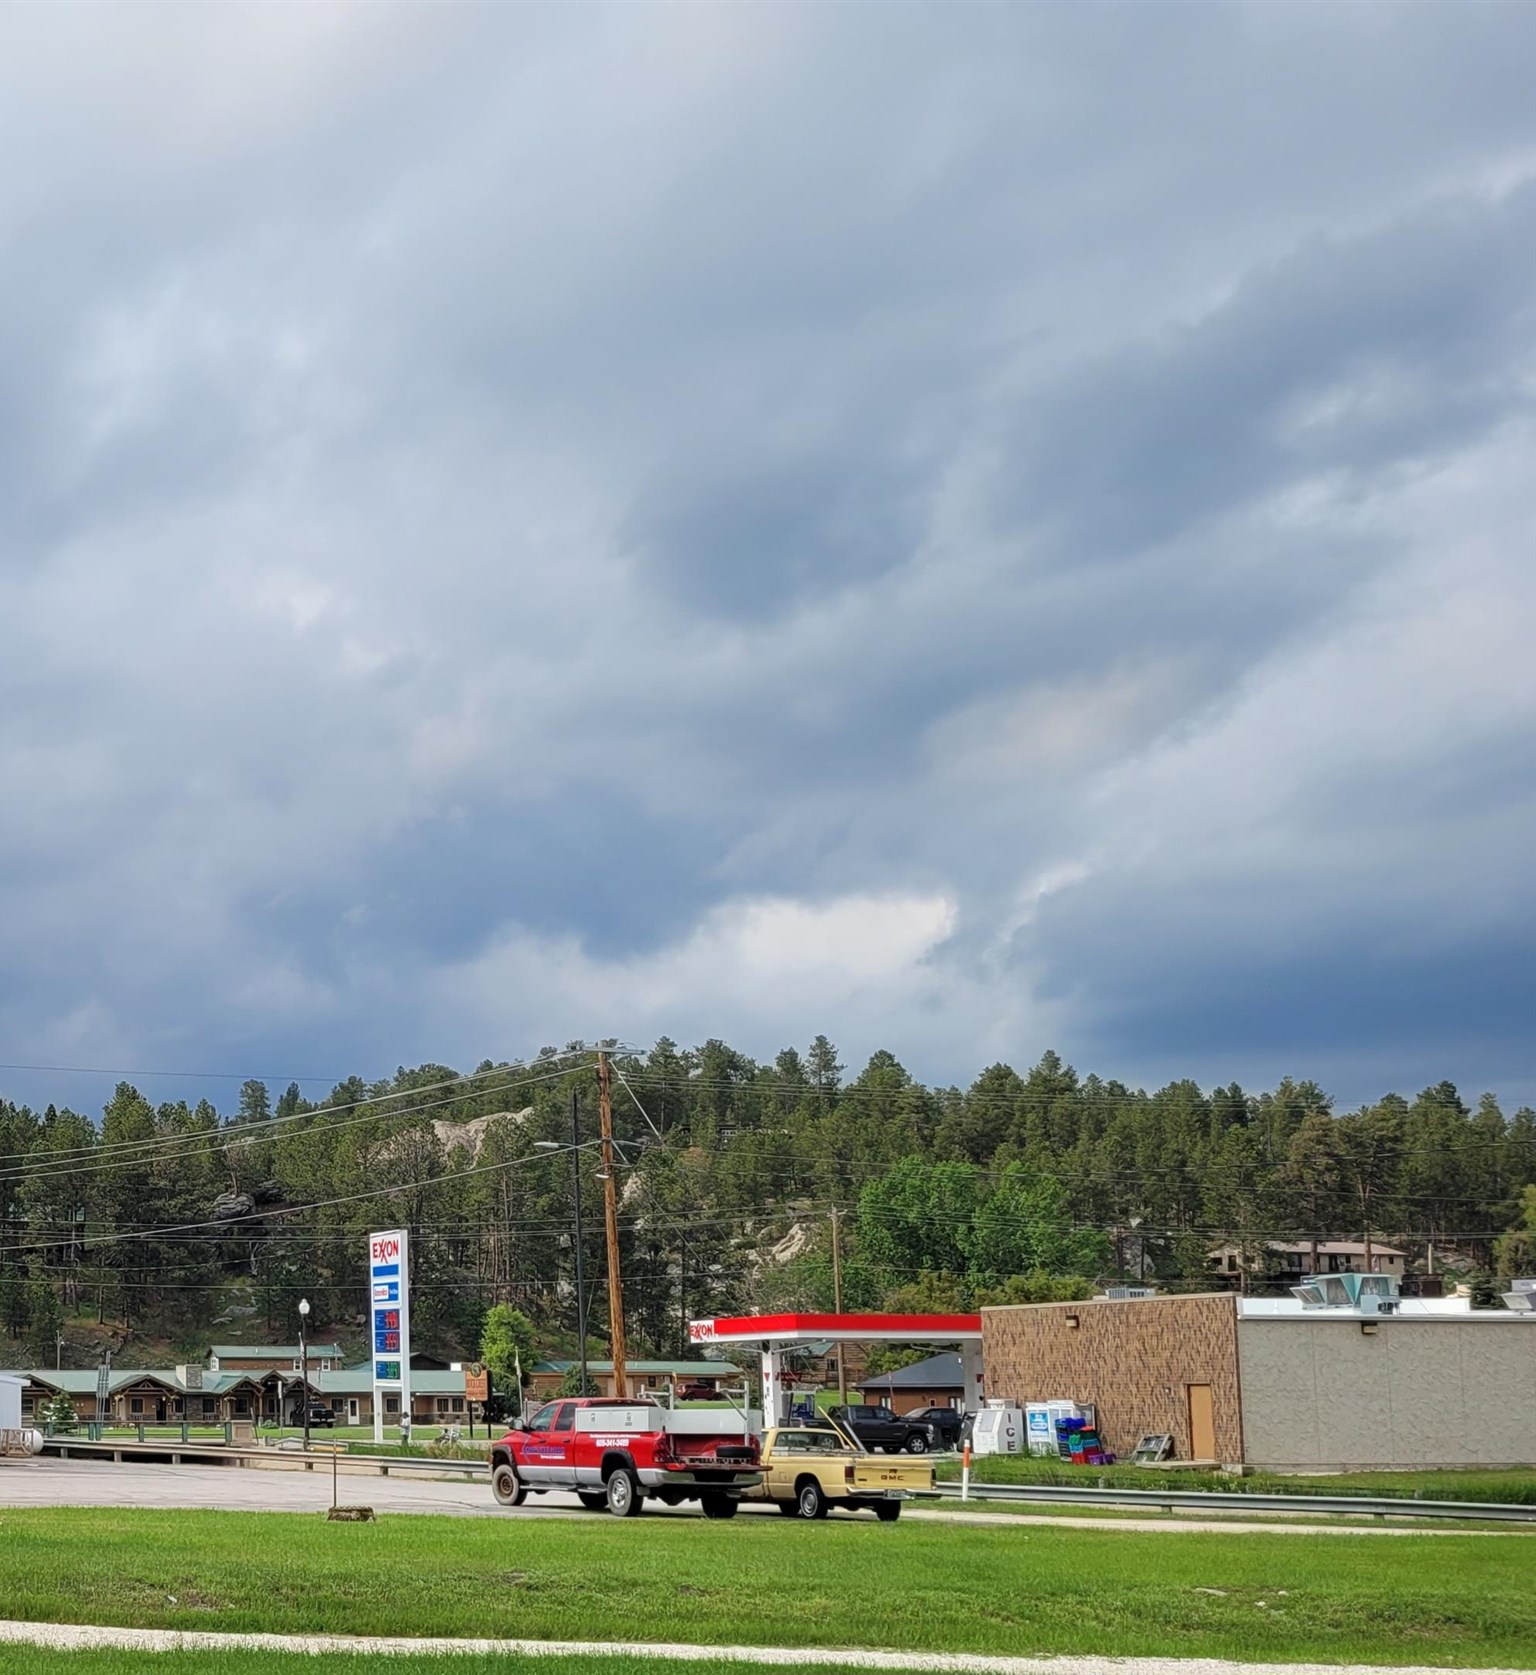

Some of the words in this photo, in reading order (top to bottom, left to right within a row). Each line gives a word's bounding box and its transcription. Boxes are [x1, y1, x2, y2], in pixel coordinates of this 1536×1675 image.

[372, 1239, 399, 1264] EXXON
[689, 1323, 713, 1340] EXXON
[1005, 1413, 1017, 1452] ICE
